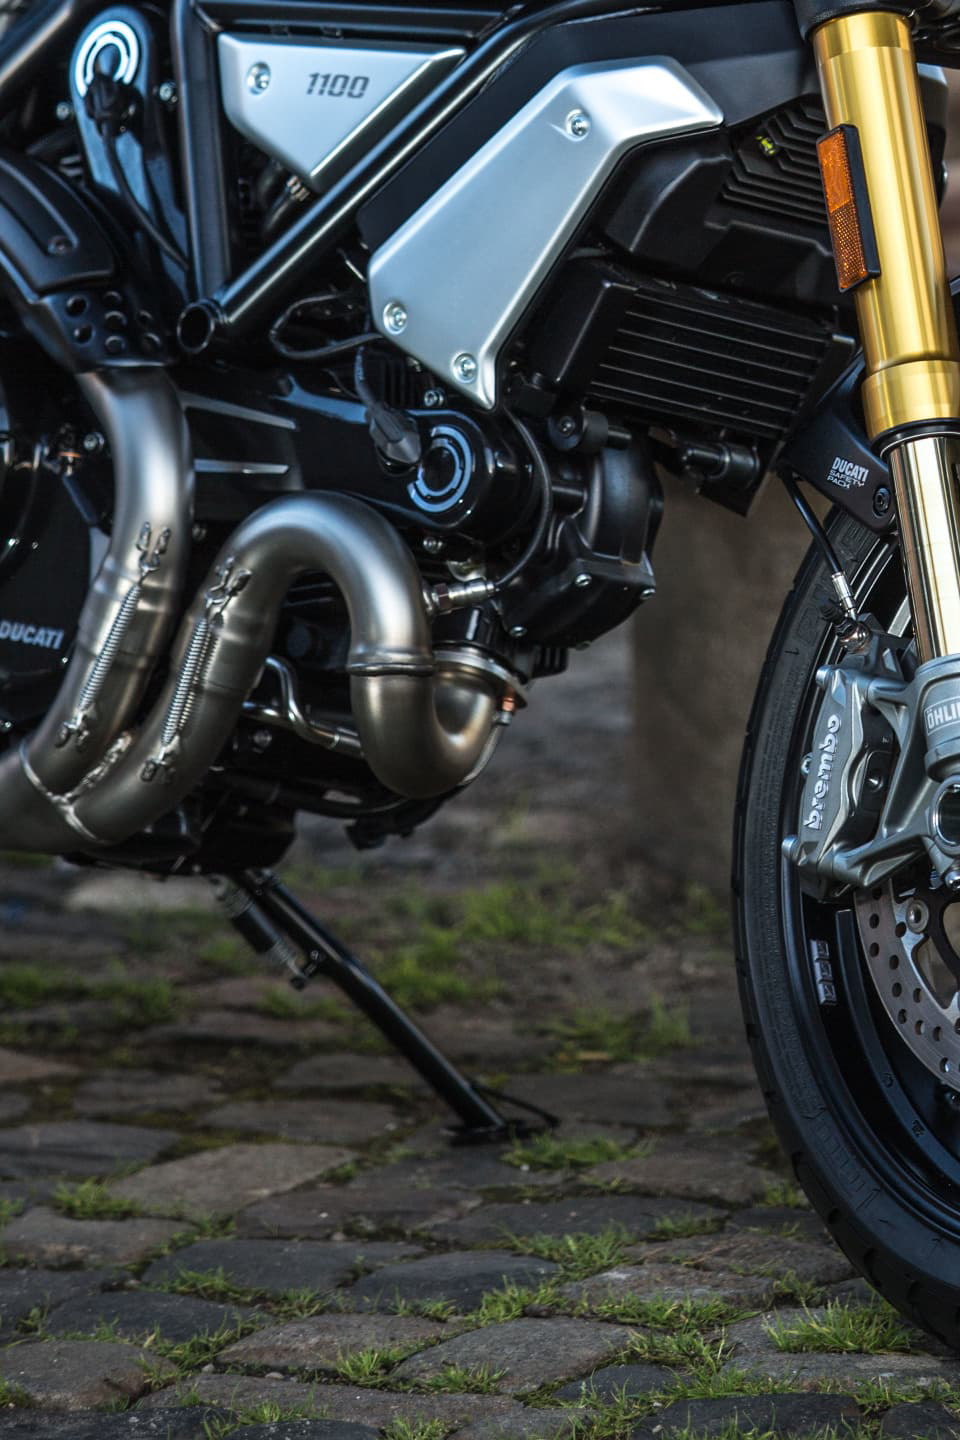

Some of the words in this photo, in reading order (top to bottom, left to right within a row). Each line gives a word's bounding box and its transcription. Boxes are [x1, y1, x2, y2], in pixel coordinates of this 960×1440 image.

[307, 72, 370, 99] 1100
[830, 470, 865, 487] SAFETY
[832, 456, 869, 482] DUCATI
[0, 620, 64, 649] DUCATI
[803, 714, 842, 830] brembo
